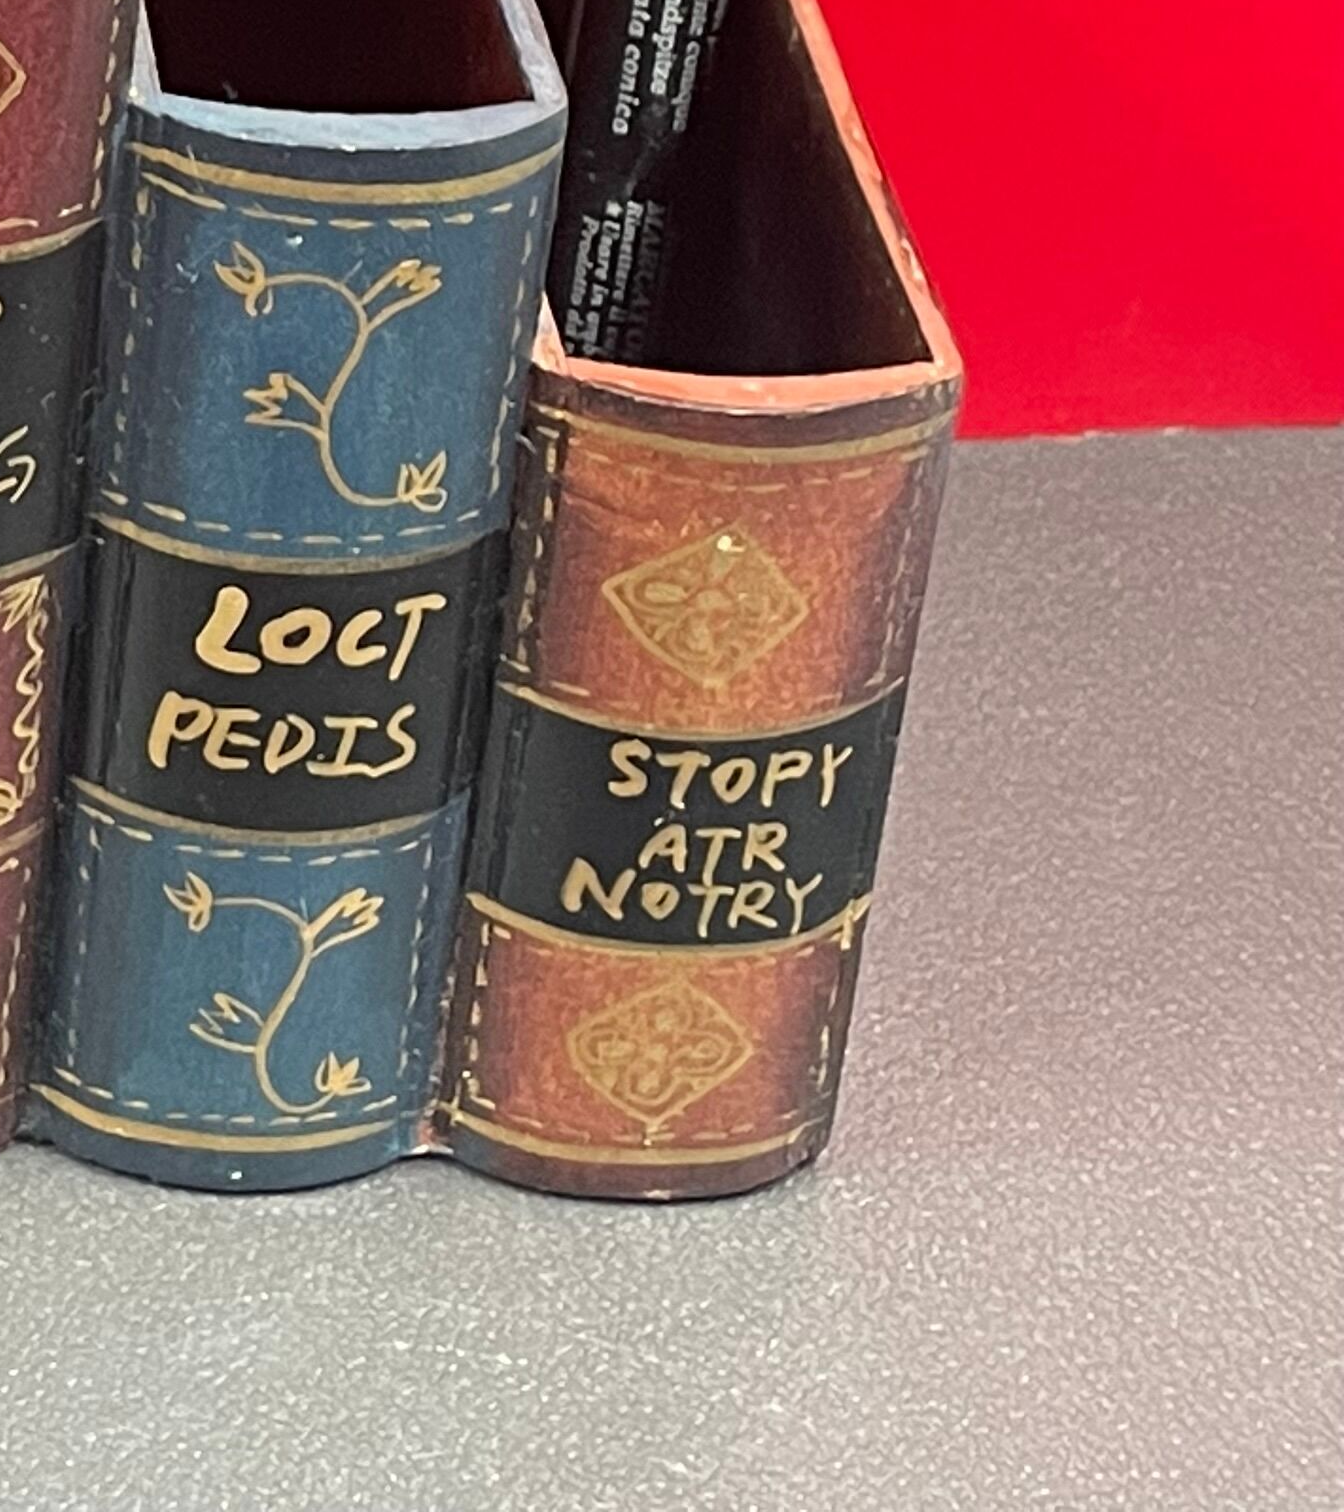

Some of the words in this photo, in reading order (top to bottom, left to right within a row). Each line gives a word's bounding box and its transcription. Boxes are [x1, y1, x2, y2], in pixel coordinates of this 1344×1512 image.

[612, 43, 642, 136] conica
[193, 584, 448, 681] LOCT
[145, 690, 419, 778] PEDIS
[607, 737, 856, 811] STOPY
[637, 820, 789, 885] ATR
[560, 856, 824, 939] NOTRY
